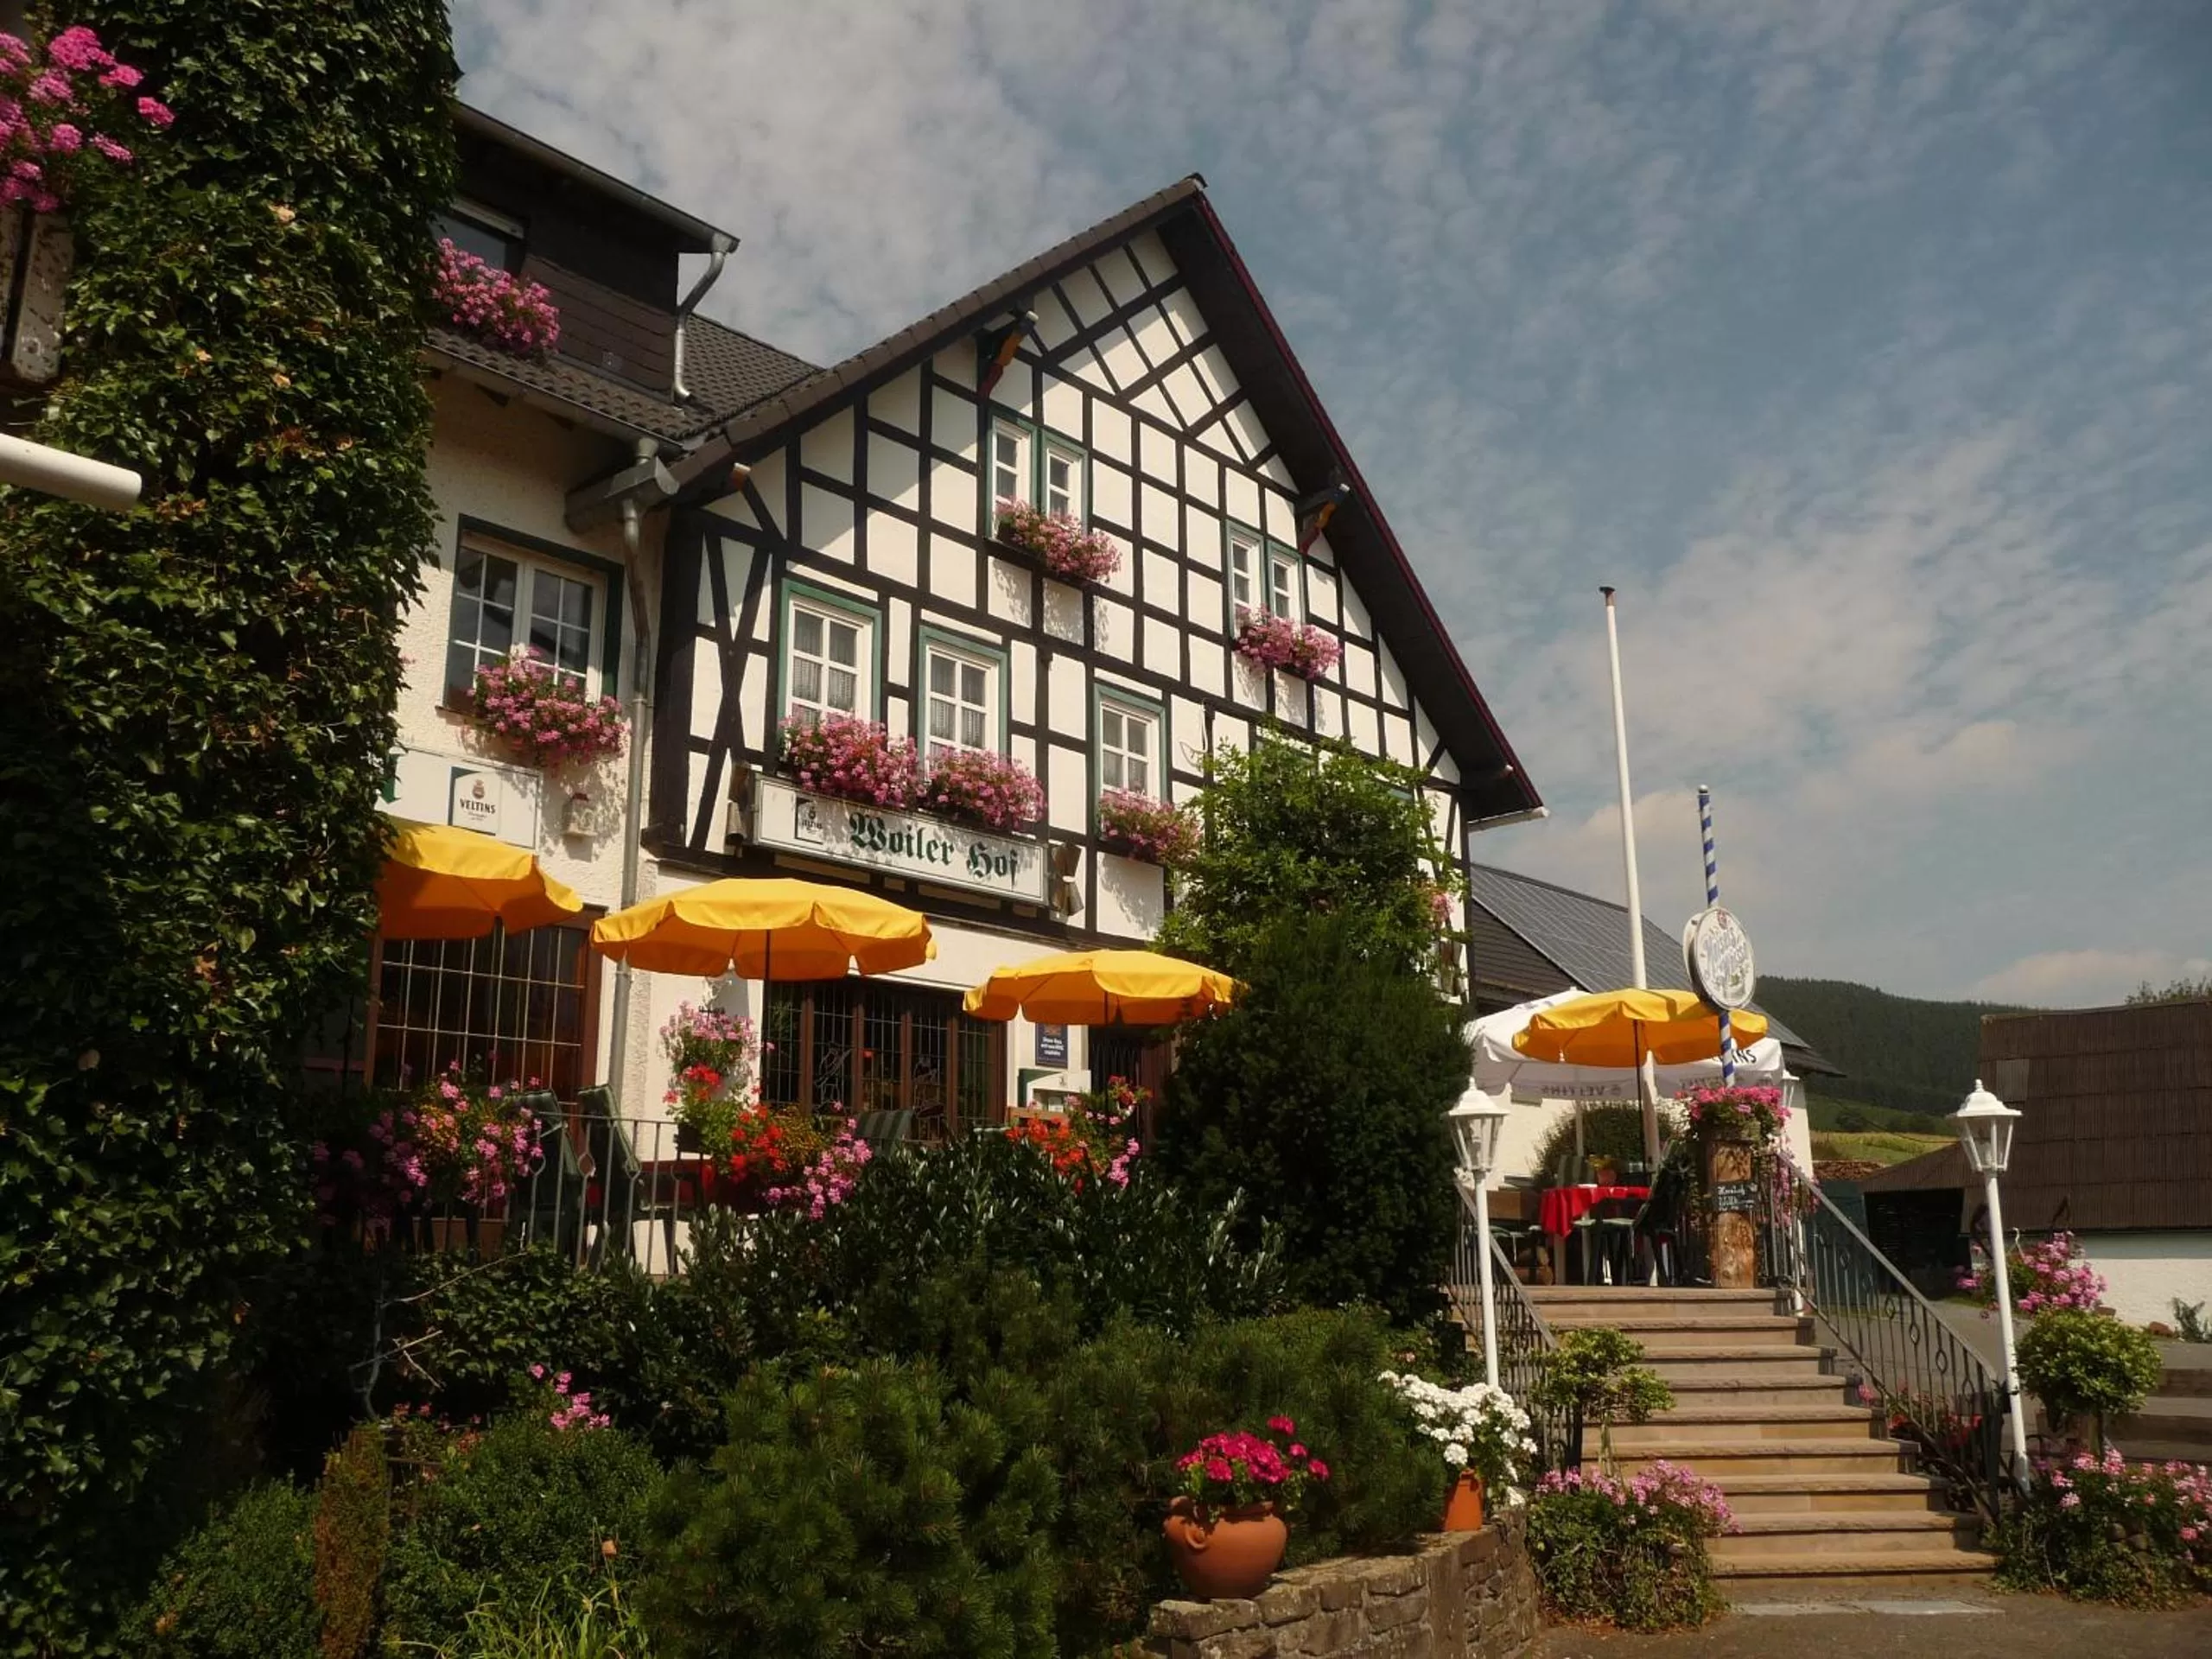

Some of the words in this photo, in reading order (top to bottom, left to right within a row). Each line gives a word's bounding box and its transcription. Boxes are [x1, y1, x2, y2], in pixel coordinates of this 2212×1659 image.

[459, 798, 496, 813] VELTINS
[849, 812, 954, 865] Woiler
[966, 842, 1018, 887] Hof
